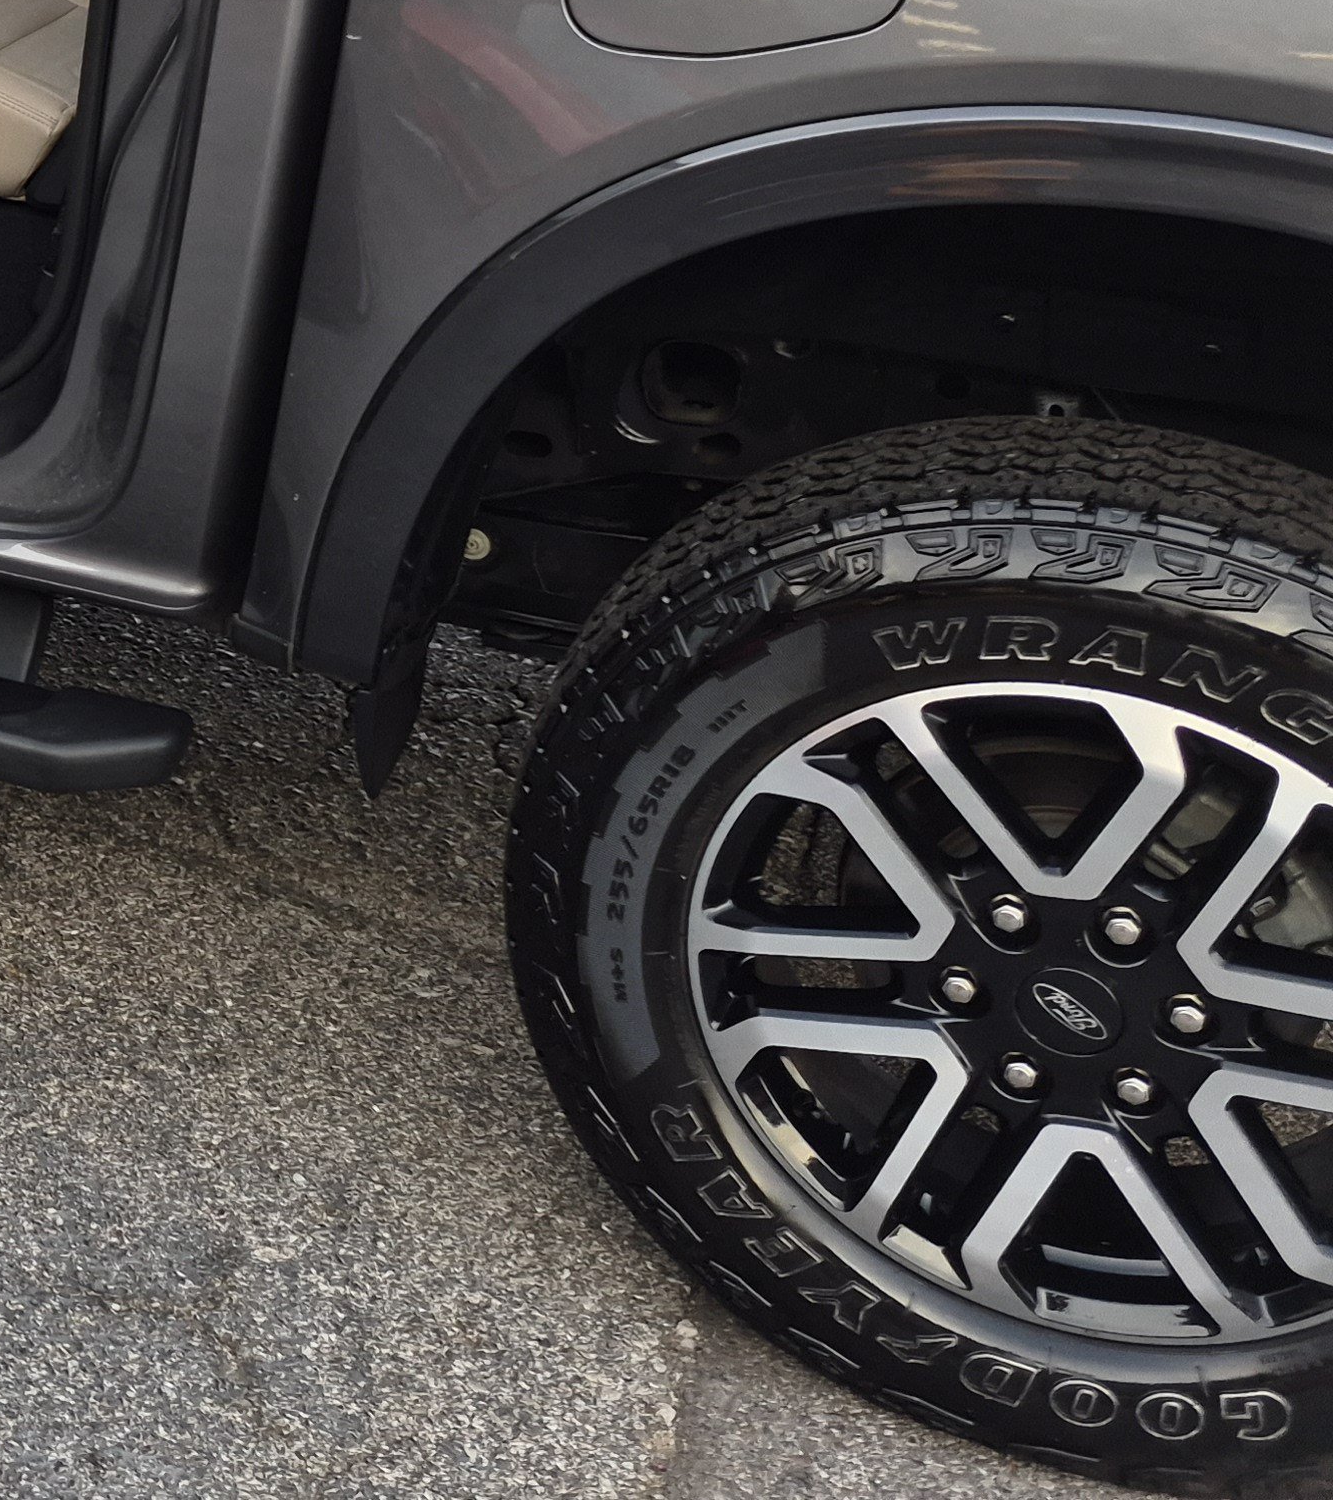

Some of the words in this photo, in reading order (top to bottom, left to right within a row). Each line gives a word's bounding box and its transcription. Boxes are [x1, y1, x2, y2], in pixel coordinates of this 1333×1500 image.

[873, 615, 1333, 745] WRANG
[605, 745, 698, 925] 255/65R18
[1043, 992, 1098, 1031] Ford
[649, 1102, 1292, 1442] GOODYEAR
